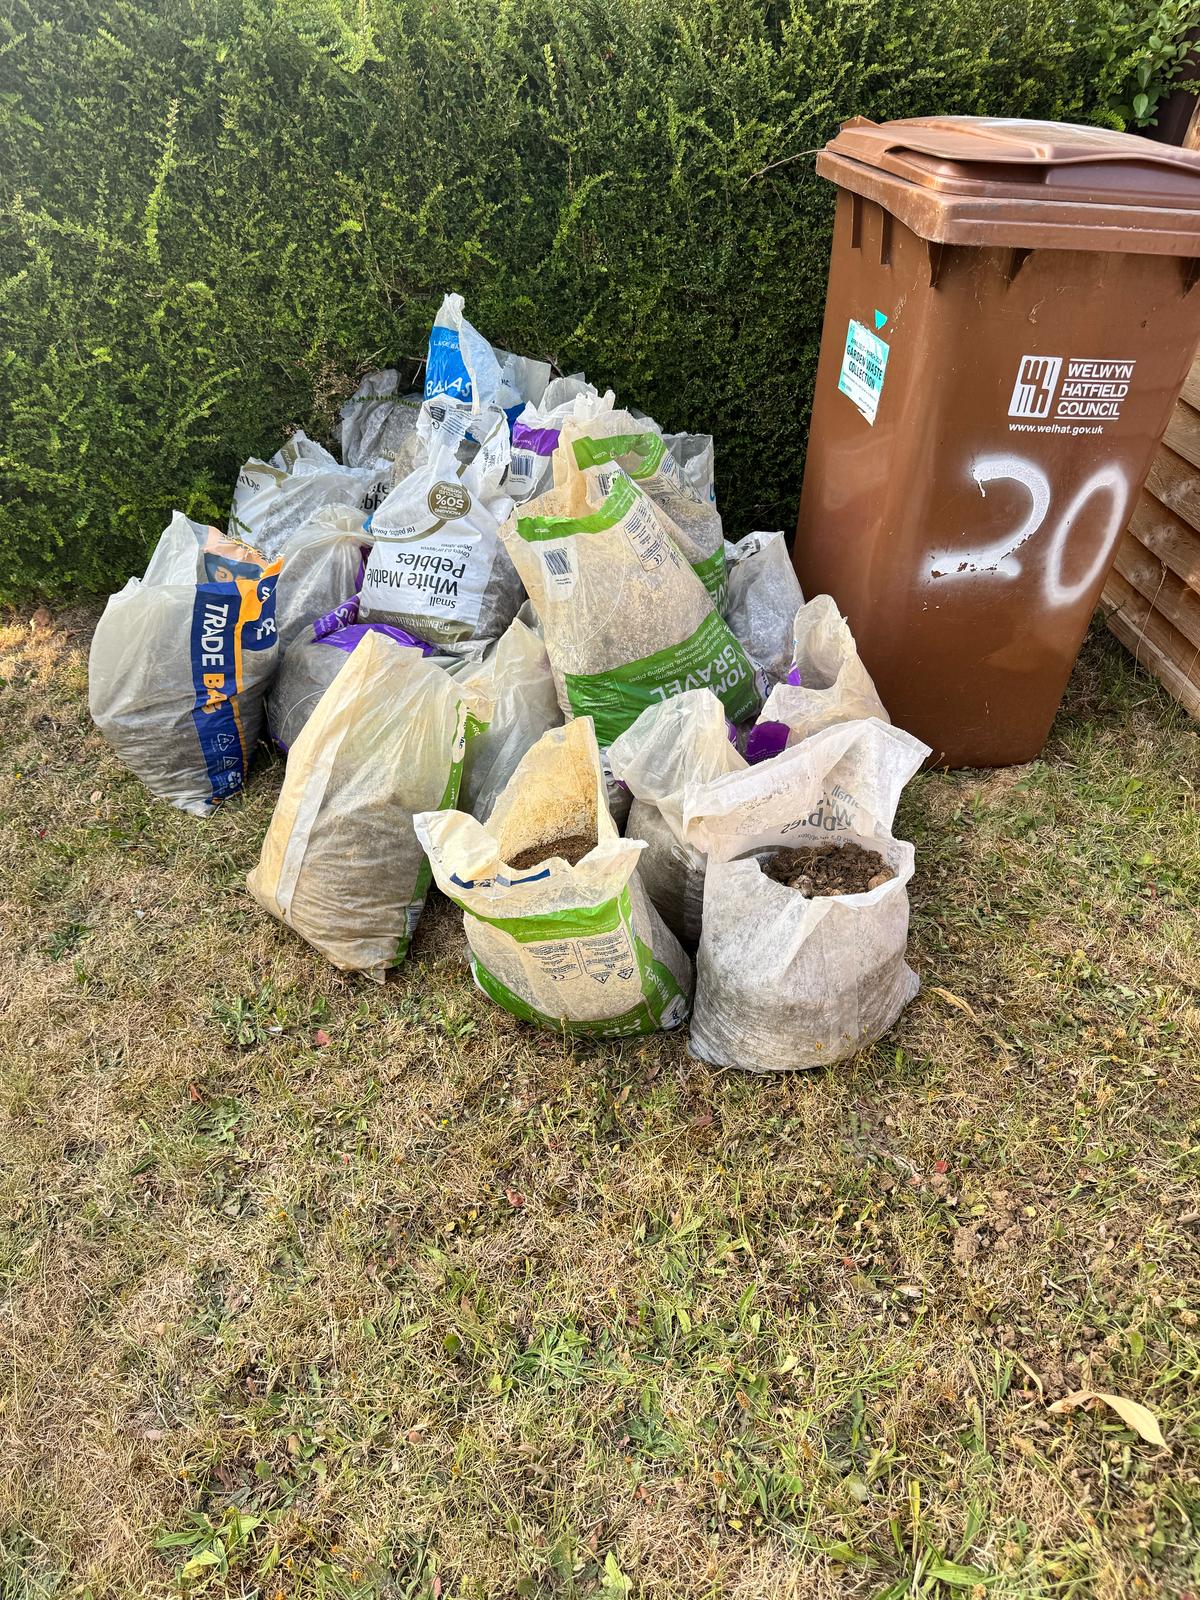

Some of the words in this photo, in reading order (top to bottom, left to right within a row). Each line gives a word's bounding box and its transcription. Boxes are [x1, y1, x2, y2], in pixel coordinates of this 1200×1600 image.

[846, 344, 866, 368] GARDEN
[865, 358, 883, 381] WASTE
[1068, 363, 1134, 379] WELWYN
[848, 360, 875, 391] COLLECTION
[1061, 382, 1128, 398] HATFIELD
[1057, 402, 1120, 416] COUNCIL
[1008, 423, 1104, 436] www.welhat.gov.uk
[435, 494, 465, 509] 50%
[924, 454, 1129, 608] 20
[395, 553, 466, 579] Pebbles
[366, 568, 404, 588] Marble
[407, 572, 458, 597] White
[429, 596, 457, 609] Small
[200, 603, 230, 668] TRADE
[628, 673, 647, 683] pipes
[647, 662, 675, 676] bedding
[649, 643, 737, 701] GRAVEL
[707, 663, 747, 697] 10M
